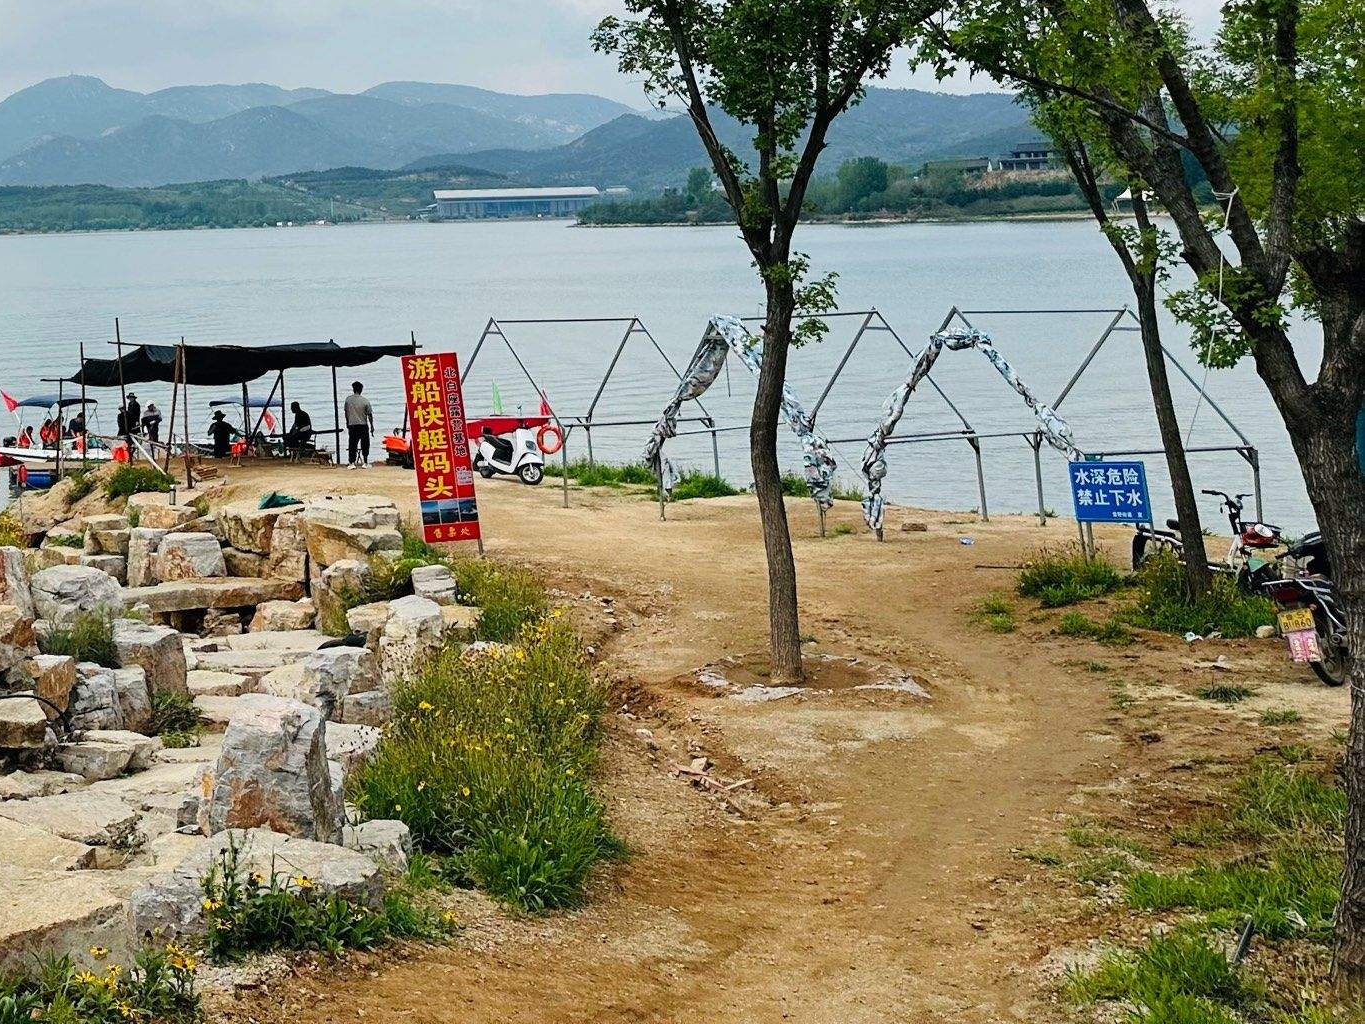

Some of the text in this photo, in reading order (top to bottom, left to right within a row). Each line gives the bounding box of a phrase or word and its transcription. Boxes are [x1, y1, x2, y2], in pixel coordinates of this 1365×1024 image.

[408, 357, 453, 499] 游船快艇码头
[1074, 467, 1140, 486] 水深危险
[1077, 488, 1143, 507] 禁止下水
